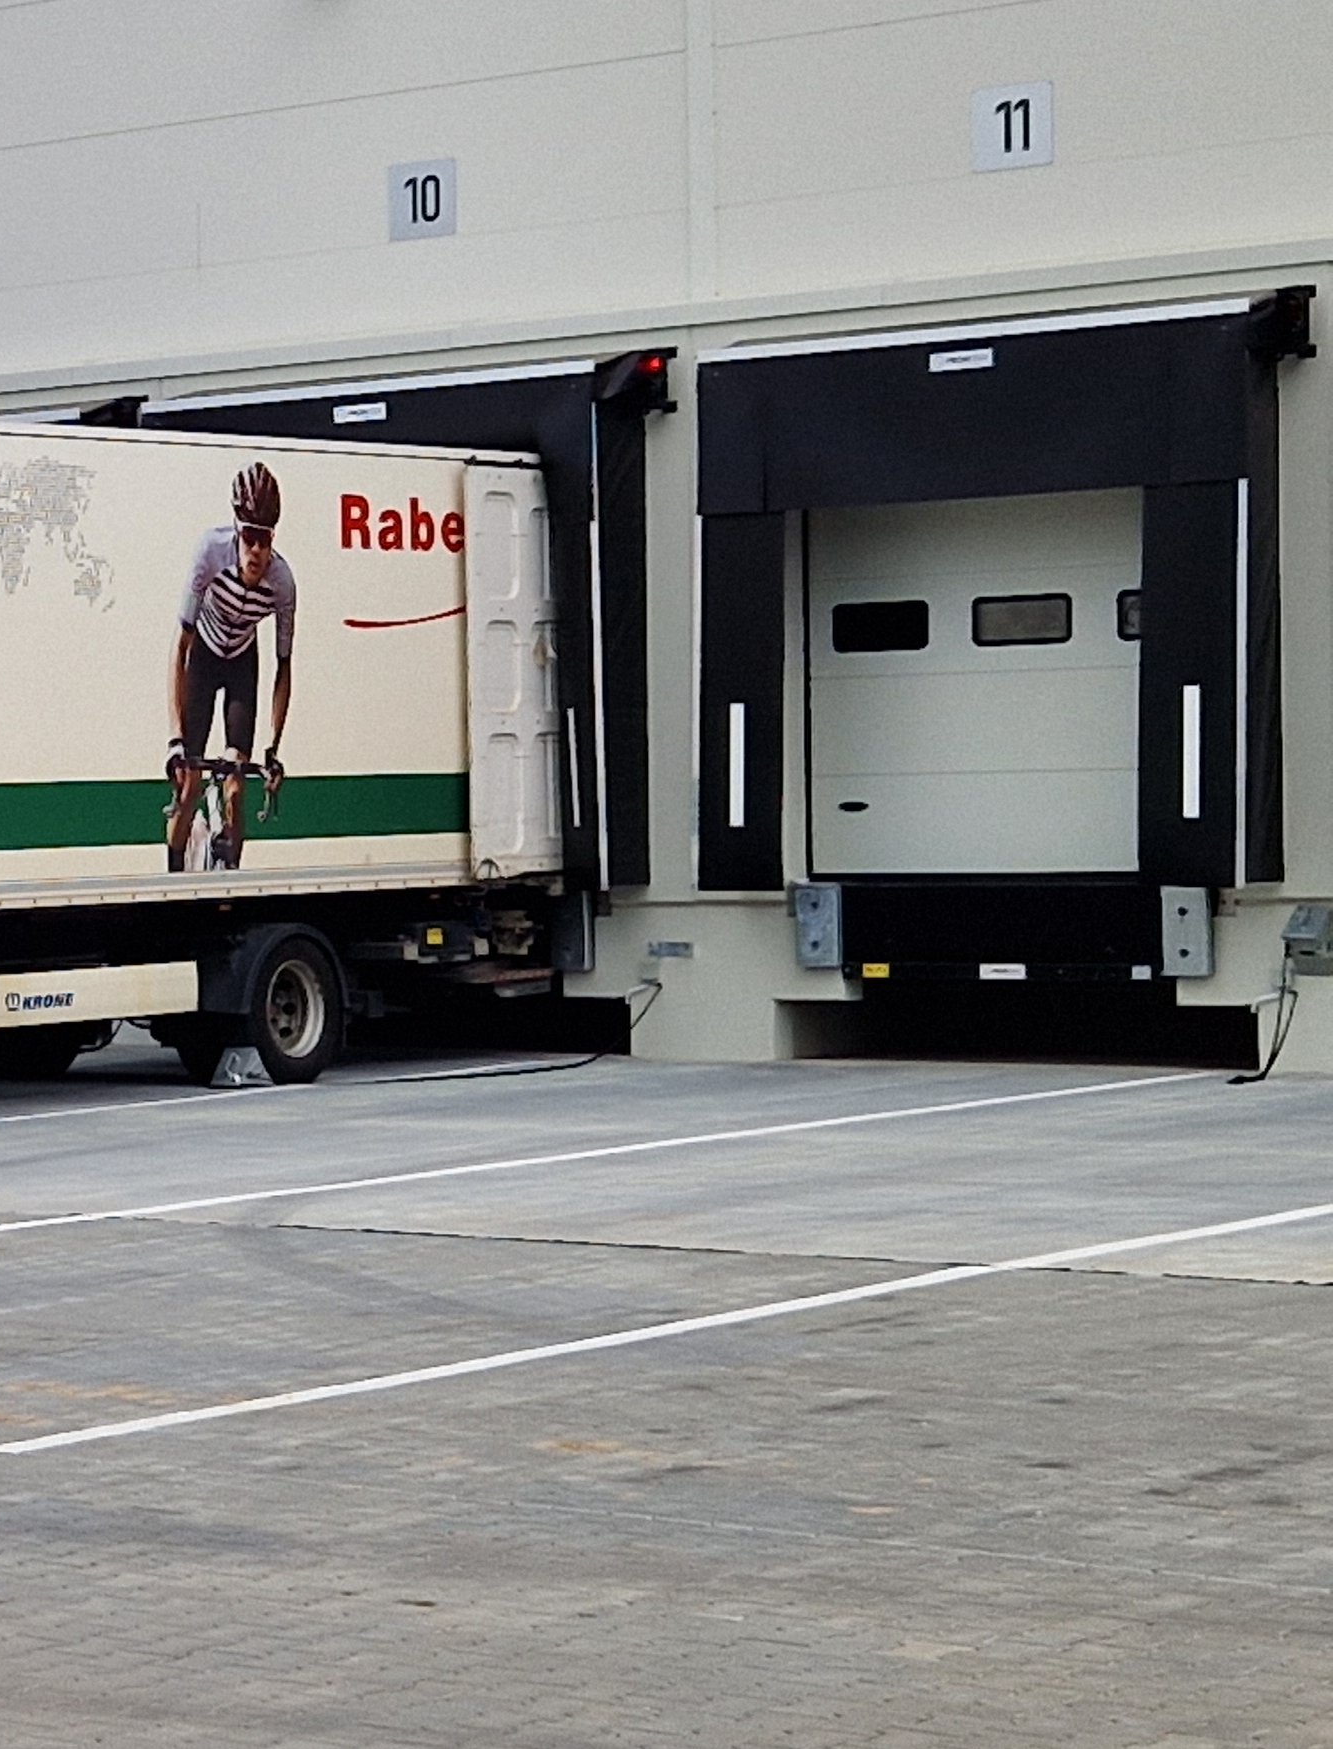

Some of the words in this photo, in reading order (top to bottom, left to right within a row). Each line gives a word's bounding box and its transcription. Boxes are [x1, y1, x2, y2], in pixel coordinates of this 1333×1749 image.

[994, 98, 1031, 154] 11
[403, 174, 441, 224] 10
[339, 494, 465, 553] Rabe
[22, 993, 75, 1010] KRONE
